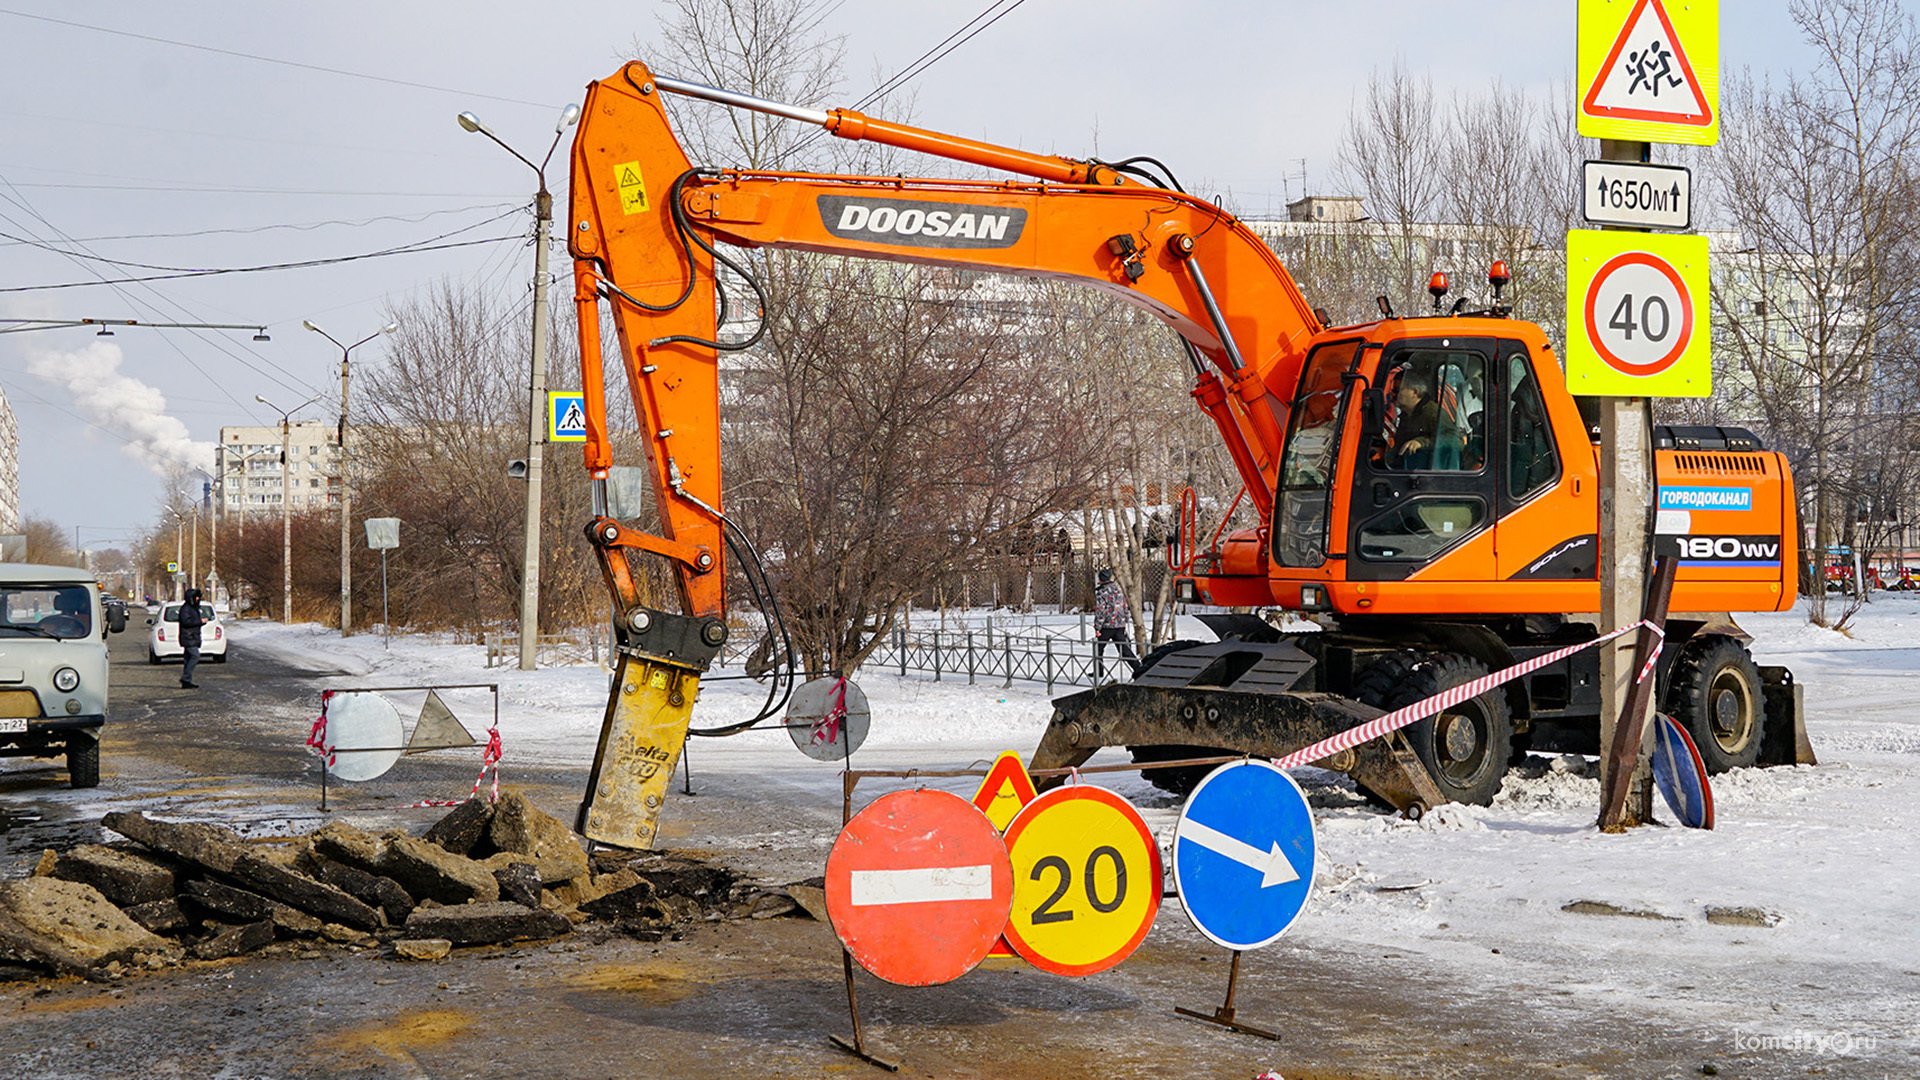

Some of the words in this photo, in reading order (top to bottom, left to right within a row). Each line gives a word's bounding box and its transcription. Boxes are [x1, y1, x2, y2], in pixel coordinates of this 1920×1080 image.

[837, 205, 1011, 240] DOOSAN
[1609, 294, 1670, 342] 40
[1661, 491, 1749, 507] ГОРВОДОКАНАЛ
[12, 719, 23, 728] 27
[1030, 845, 1127, 925] 20
